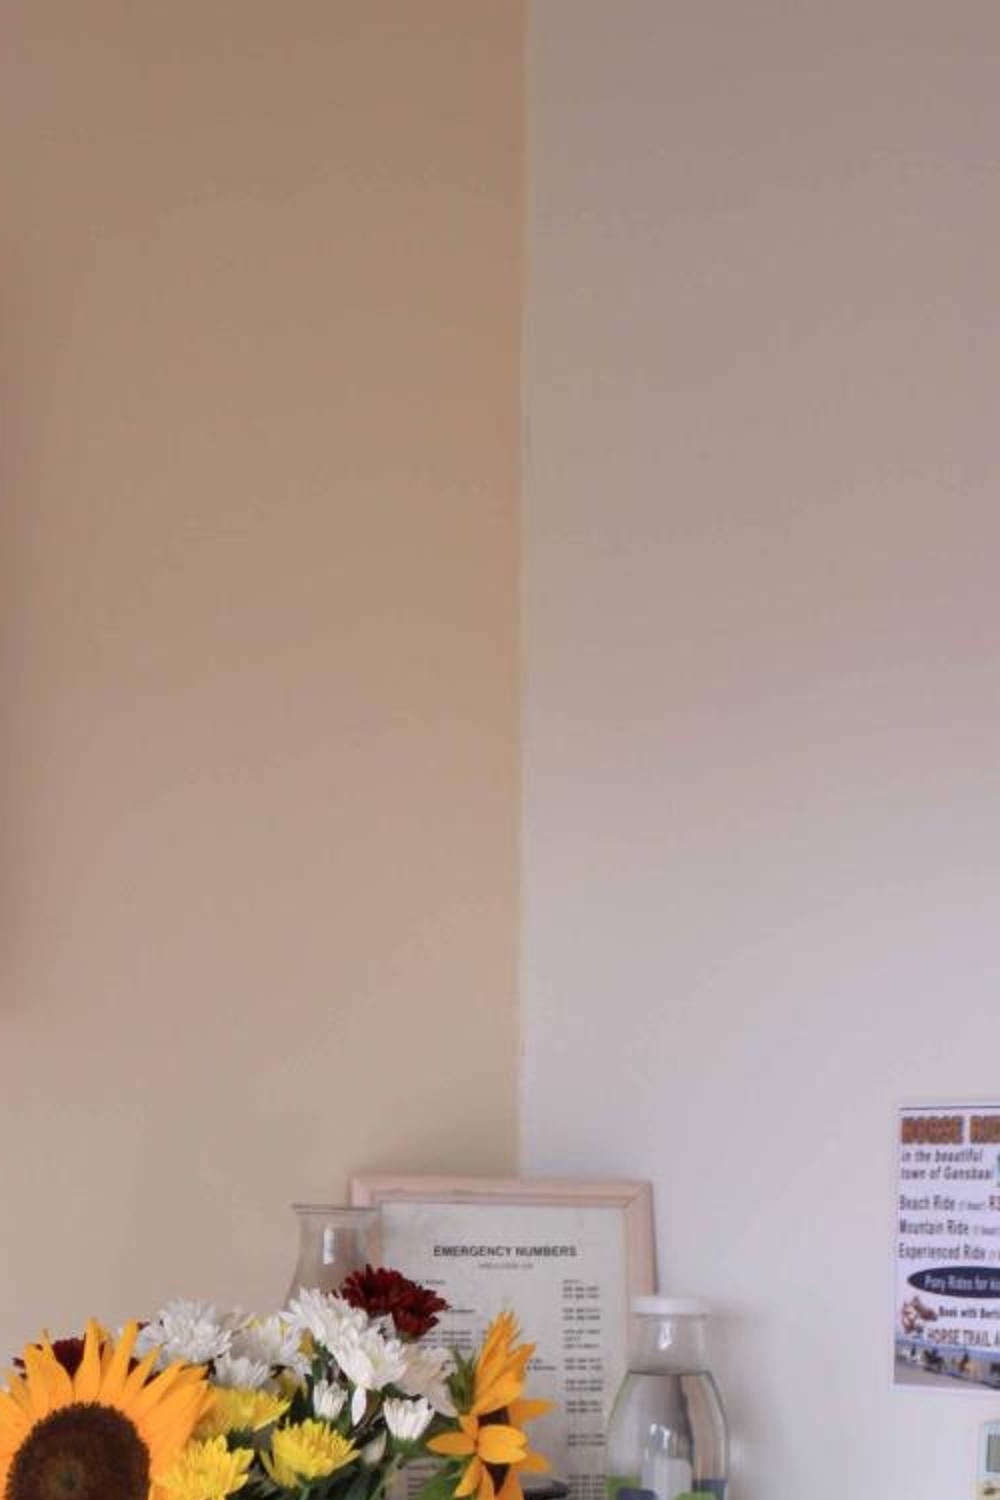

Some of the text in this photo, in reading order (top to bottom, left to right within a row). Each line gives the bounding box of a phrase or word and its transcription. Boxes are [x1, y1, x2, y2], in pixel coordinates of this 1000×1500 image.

[915, 1150, 931, 1162] the
[935, 1148, 983, 1163] beautiful
[901, 1168, 926, 1180] town
[930, 1166, 941, 1180] of
[899, 1194, 929, 1211] Beach
[933, 1195, 954, 1211] Ride
[900, 1219, 943, 1235] Mountain
[947, 1219, 969, 1235] Ride
[433, 1245, 577, 1257] EMERGENCY NUMBERS
[899, 1242, 960, 1260] Experienced
[963, 1244, 985, 1260] Ride
